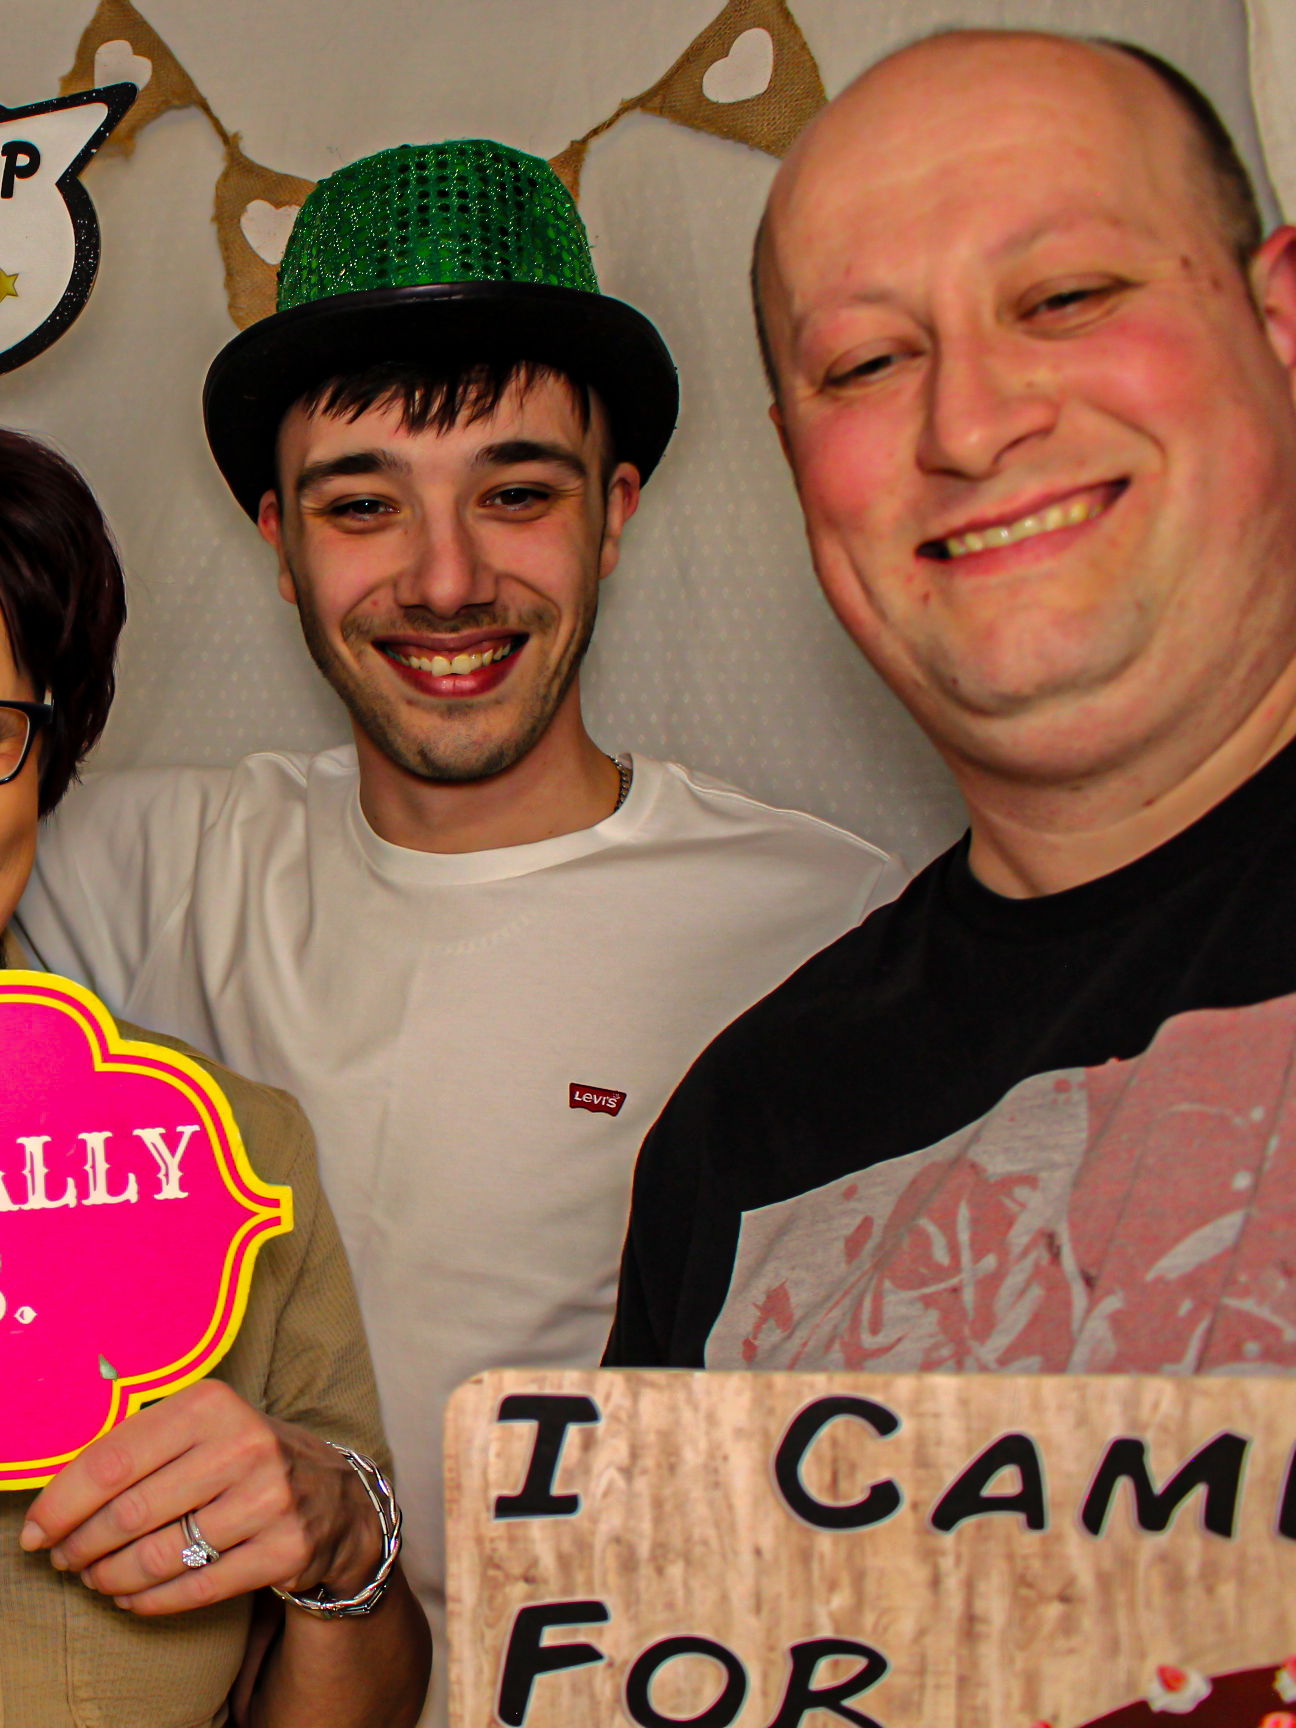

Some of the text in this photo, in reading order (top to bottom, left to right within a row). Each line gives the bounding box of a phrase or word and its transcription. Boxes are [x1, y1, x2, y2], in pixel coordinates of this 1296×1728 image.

[493, 1393, 1296, 1541] I CAM
[496, 1600, 892, 1728] FOR
